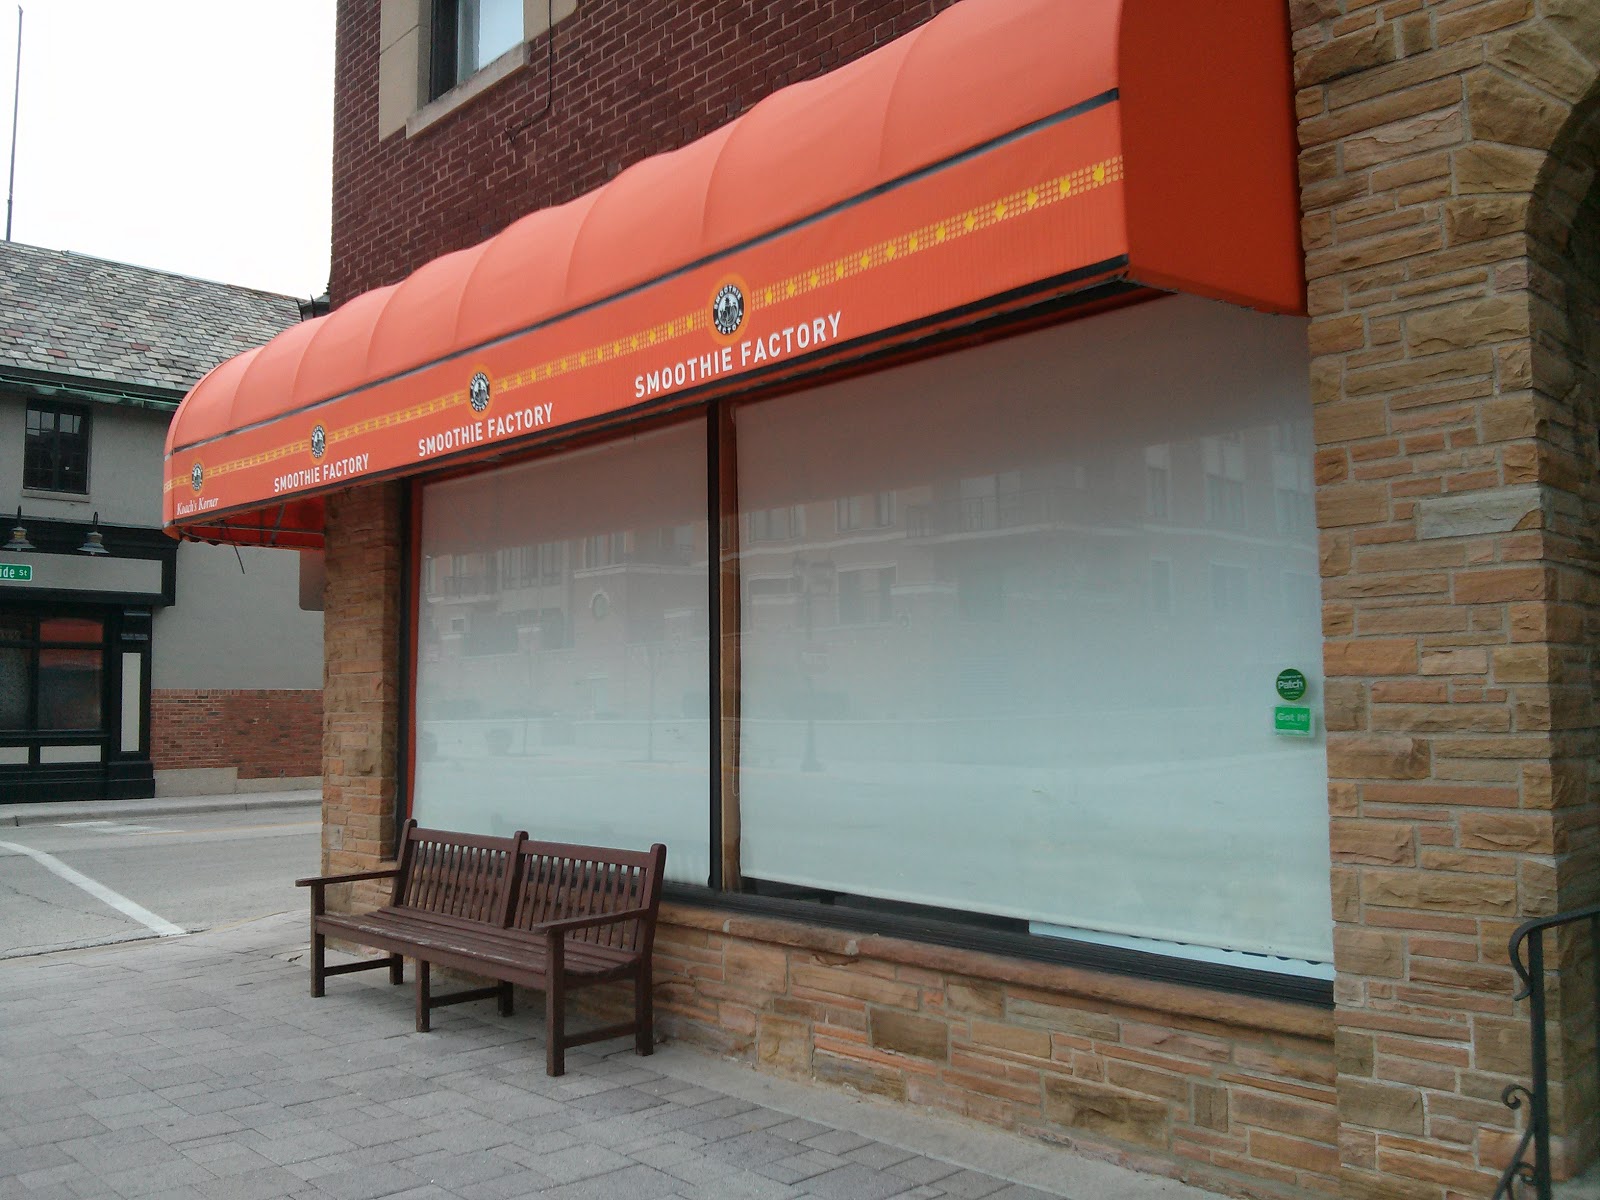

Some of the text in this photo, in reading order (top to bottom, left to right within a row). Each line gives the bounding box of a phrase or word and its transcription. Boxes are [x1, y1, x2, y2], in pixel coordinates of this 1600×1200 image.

[635, 311, 842, 398] SMOOTHIE FACTORY
[418, 402, 553, 457] SMOOTHIE FACTORY
[274, 453, 369, 493] SMOOTHIE FACTORY
[198, 497, 219, 510] Korner
[18, 569, 28, 577] St
[1277, 680, 1304, 689] Patch
